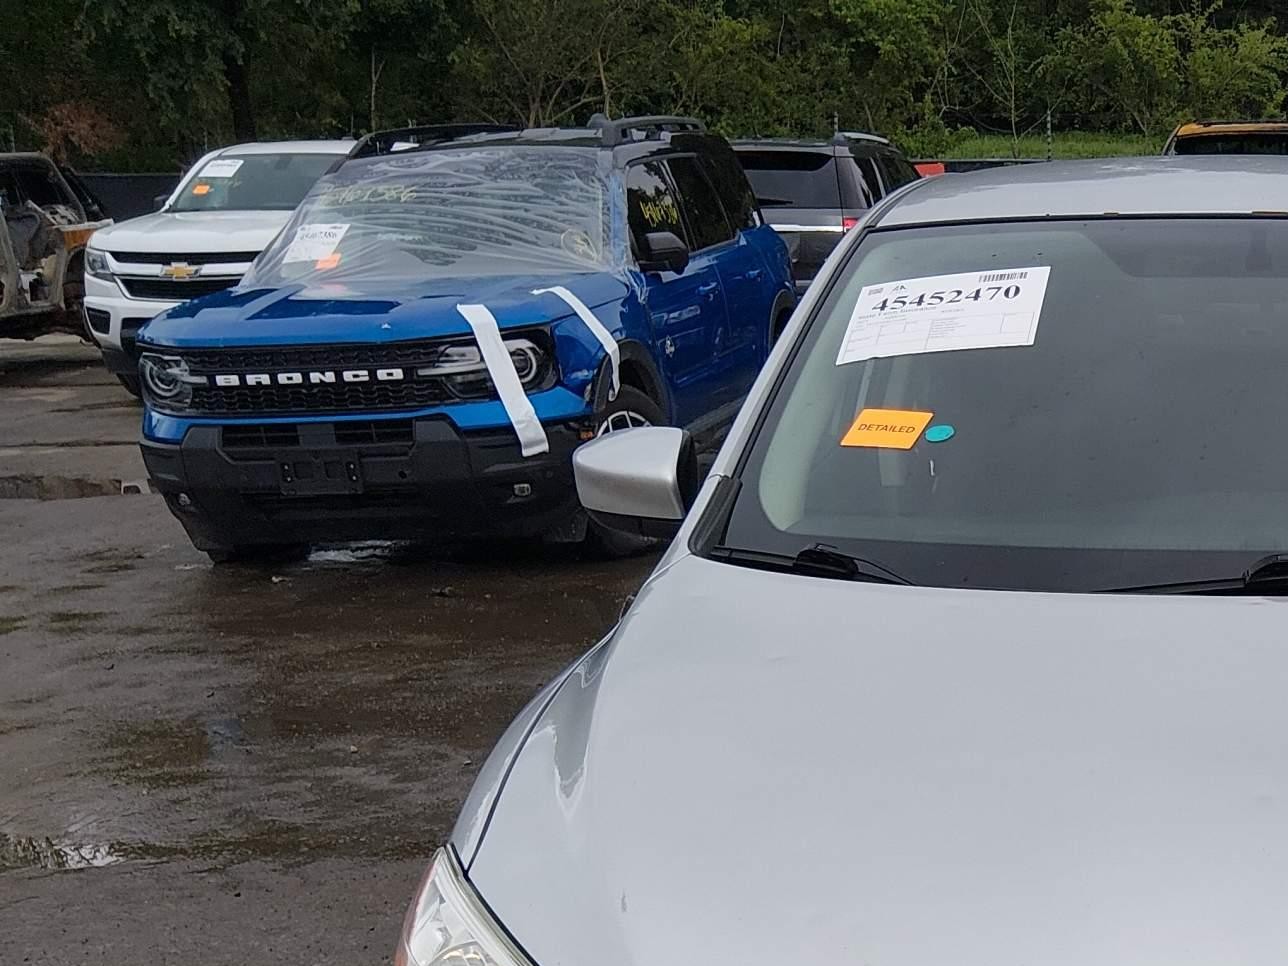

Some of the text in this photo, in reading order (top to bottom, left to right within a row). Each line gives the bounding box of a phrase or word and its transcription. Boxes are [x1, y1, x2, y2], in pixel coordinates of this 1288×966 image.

[871, 283, 1021, 312] 45452470
[215, 368, 405, 387] BRONCO
[857, 423, 916, 434] DETAILED
